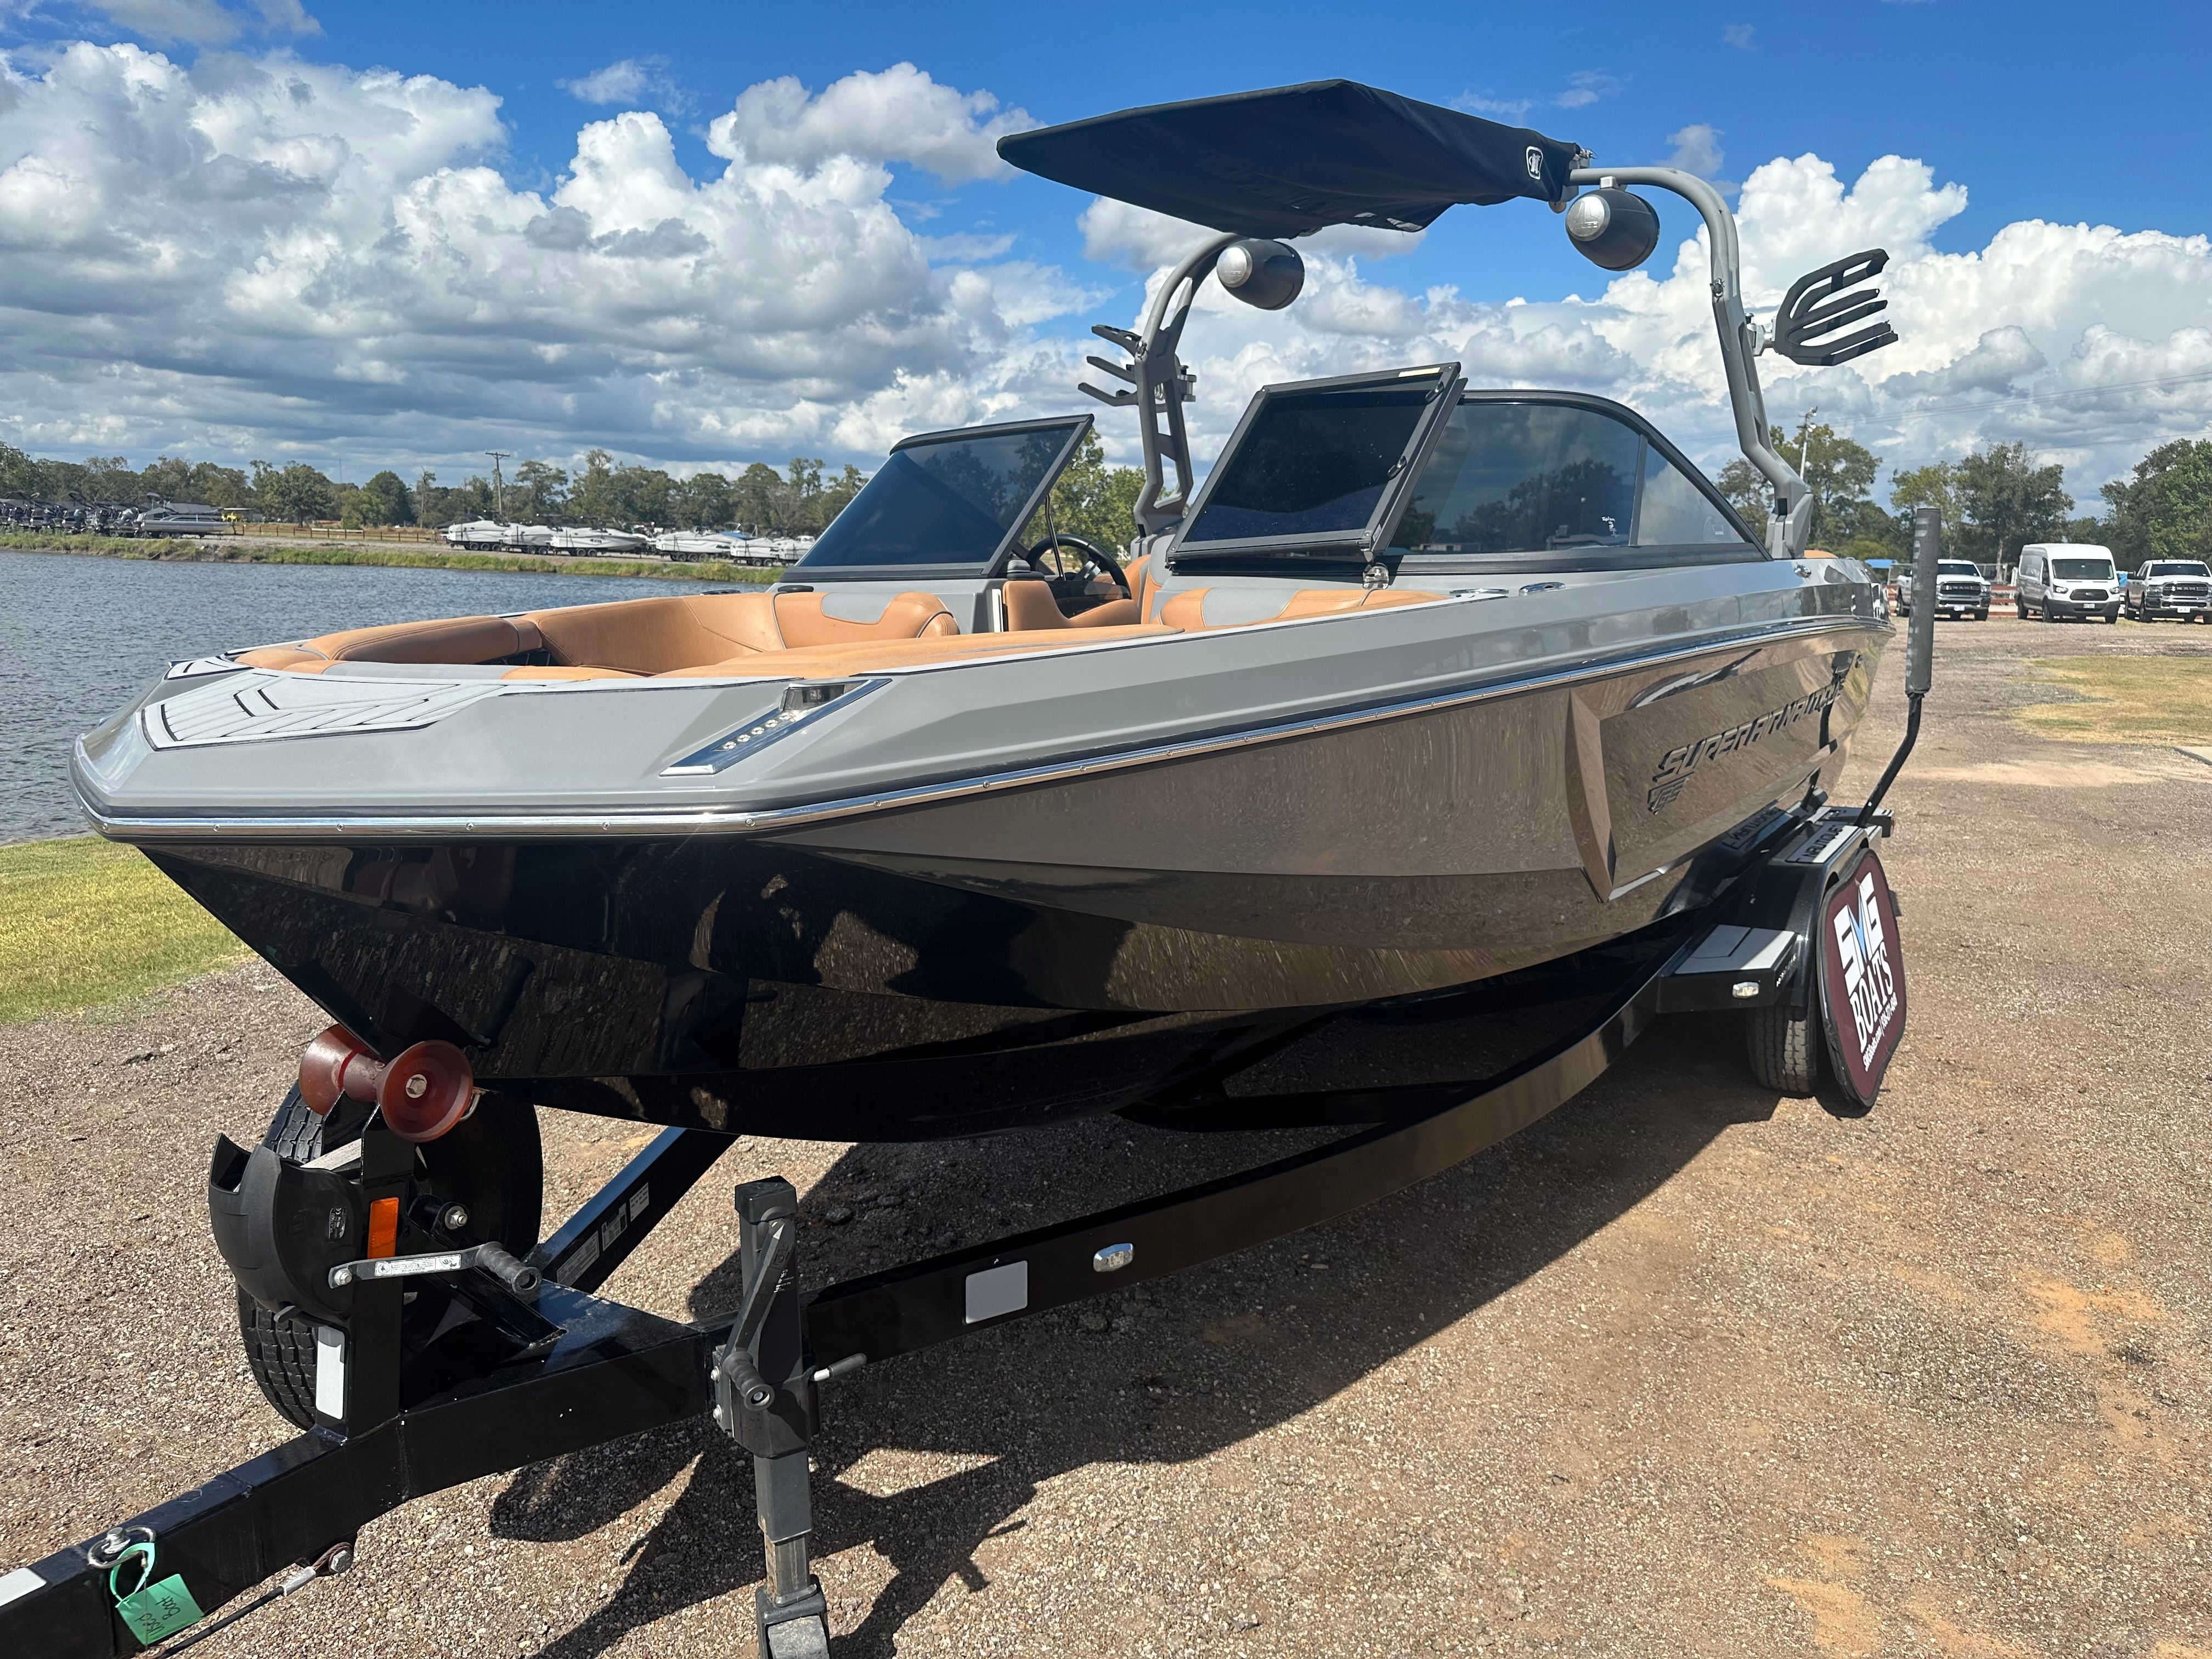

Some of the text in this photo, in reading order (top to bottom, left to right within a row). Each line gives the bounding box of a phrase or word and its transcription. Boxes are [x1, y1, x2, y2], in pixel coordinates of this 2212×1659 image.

[1833, 872, 1884, 997] SMG
[1849, 941, 1893, 1053] BOATS
[134, 1613, 165, 1636] Used
[155, 1595, 181, 1620] Boat
